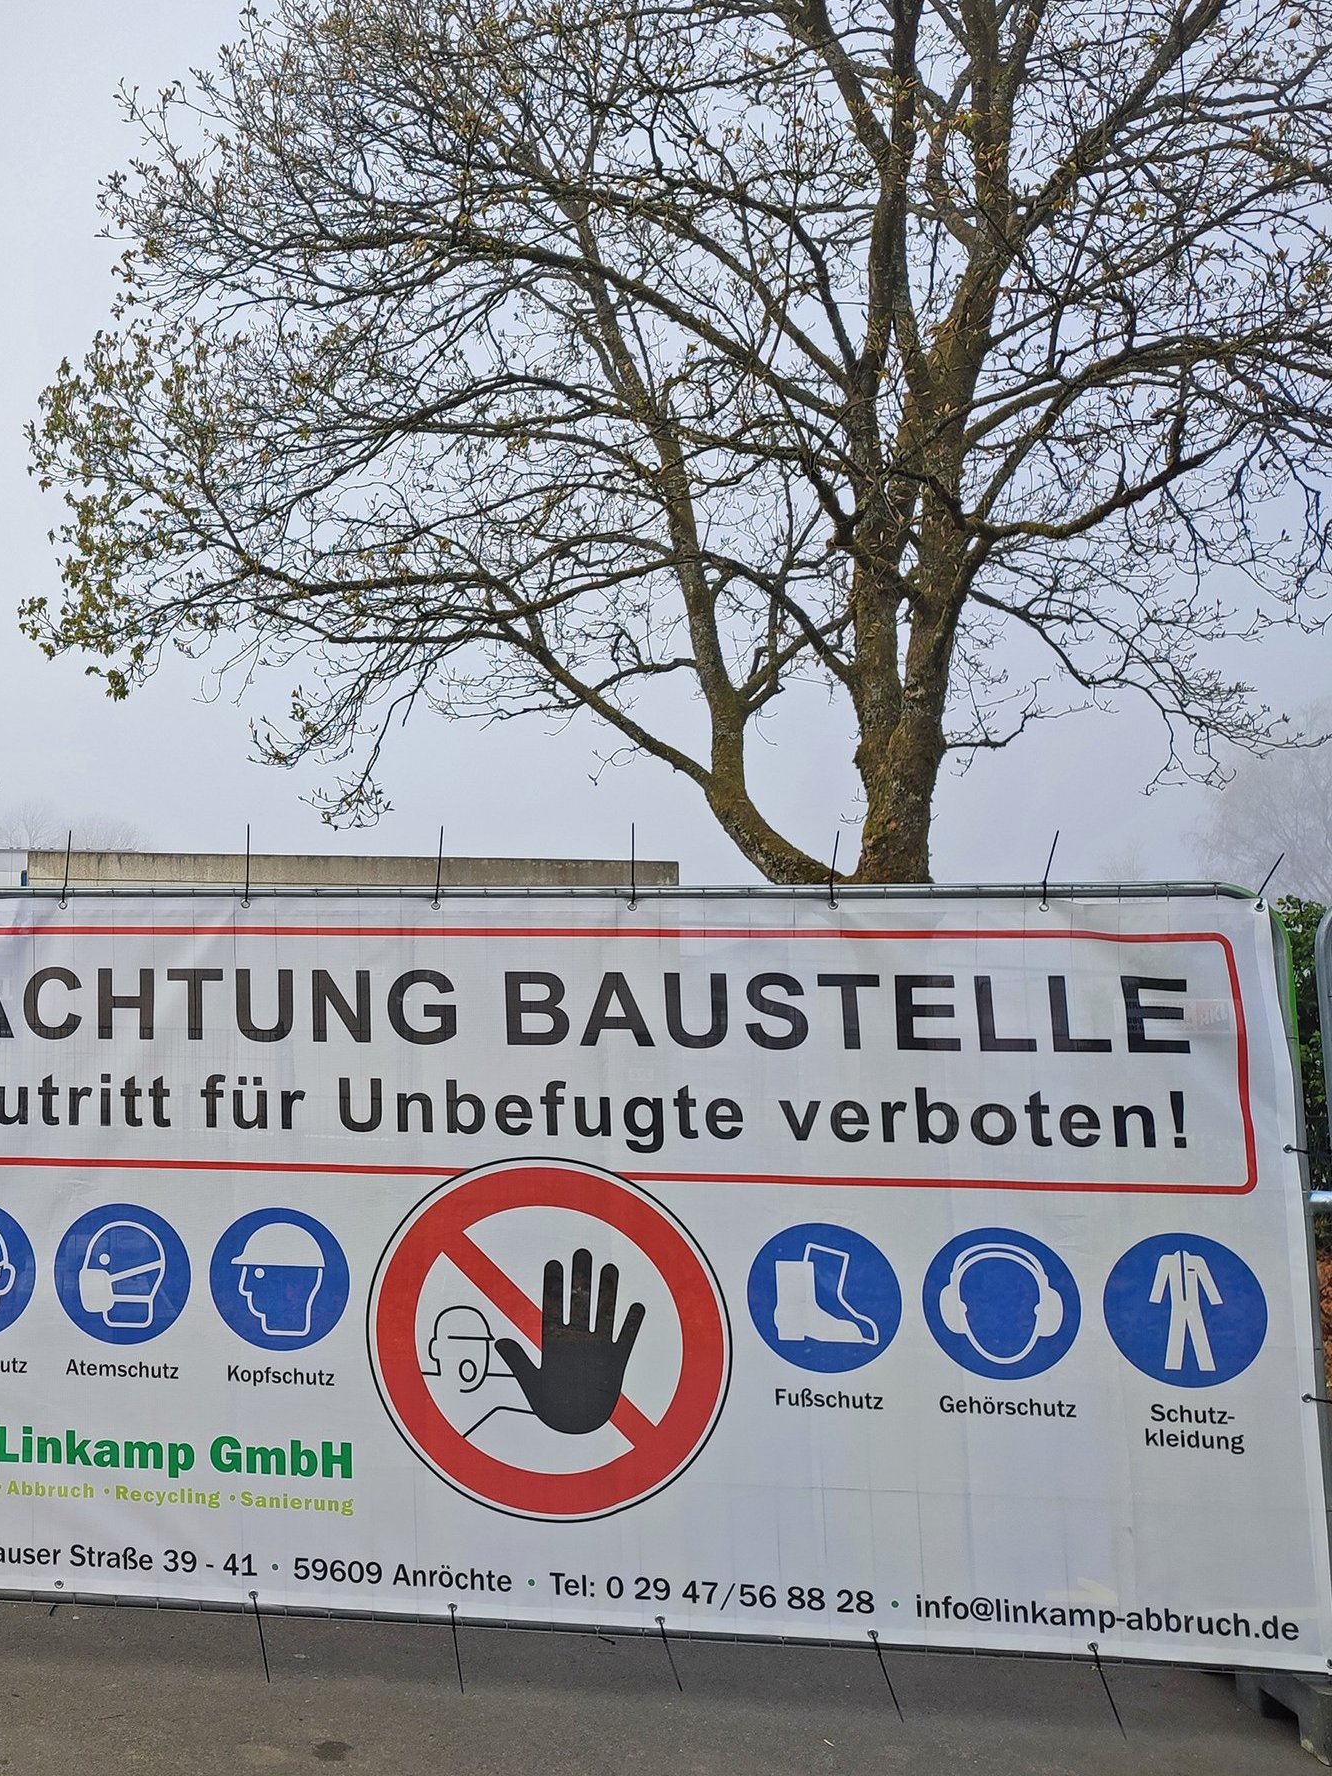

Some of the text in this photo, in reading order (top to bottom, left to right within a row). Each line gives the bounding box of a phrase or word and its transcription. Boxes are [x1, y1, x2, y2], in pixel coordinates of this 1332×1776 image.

[504, 971, 1192, 1055] BAUSTELLE
[200, 1073, 306, 1130] für
[338, 1077, 744, 1153] Unbefugte
[778, 1086, 1188, 1149] verboten!
[65, 1358, 179, 1380] Atemschutz
[227, 1364, 335, 1387] Kopfschutz
[775, 1387, 884, 1410] Fußschutz
[939, 1395, 1077, 1418] Gehörschutz
[1150, 1403, 1235, 1425] Schutz-
[1144, 1427, 1245, 1455] kleidung
[209, 1435, 353, 1479] GmbH
[6, 1480, 354, 1517] Abbruch Recycling Sanierung
[69, 1544, 154, 1571] Straße
[163, 1549, 197, 1573] 39
[222, 1553, 258, 1577] 41
[293, 1557, 383, 1585] 59609
[392, 1563, 512, 1593] Anröchte
[549, 1572, 595, 1598] Tel:
[606, 1575, 624, 1599] 0
[634, 1576, 671, 1601] 29
[681, 1580, 777, 1611] 47/56
[787, 1586, 826, 1611] 88
[836, 1589, 875, 1614] 28
[916, 1593, 1300, 1642] info@linkamp-abbruch.de
